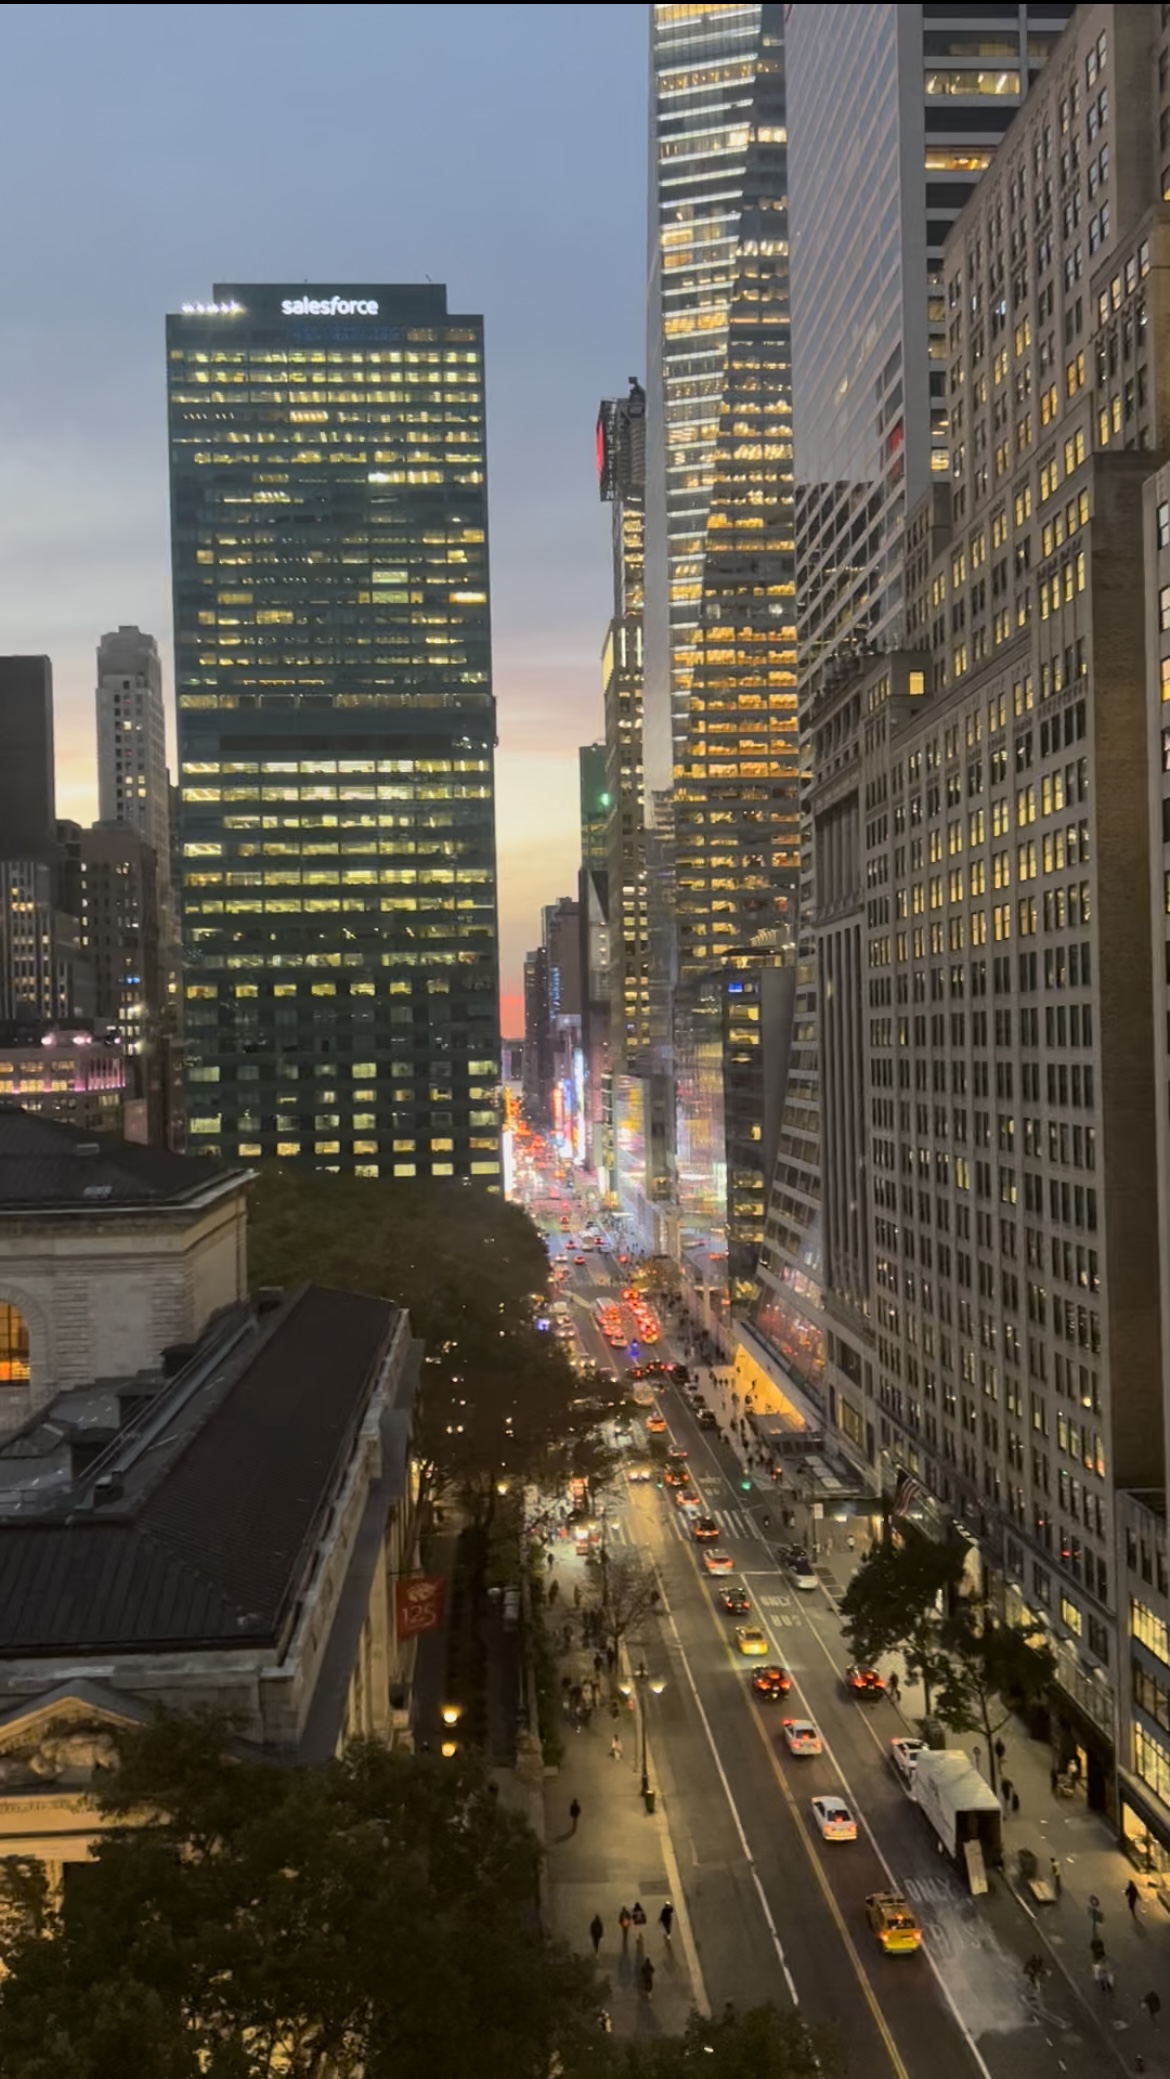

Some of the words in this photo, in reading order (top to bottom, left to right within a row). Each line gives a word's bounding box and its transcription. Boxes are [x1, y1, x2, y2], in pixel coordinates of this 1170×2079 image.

[281, 296, 379, 316] salesforce
[759, 1595, 791, 1606] ONLY
[903, 1877, 958, 1902] ONLY
